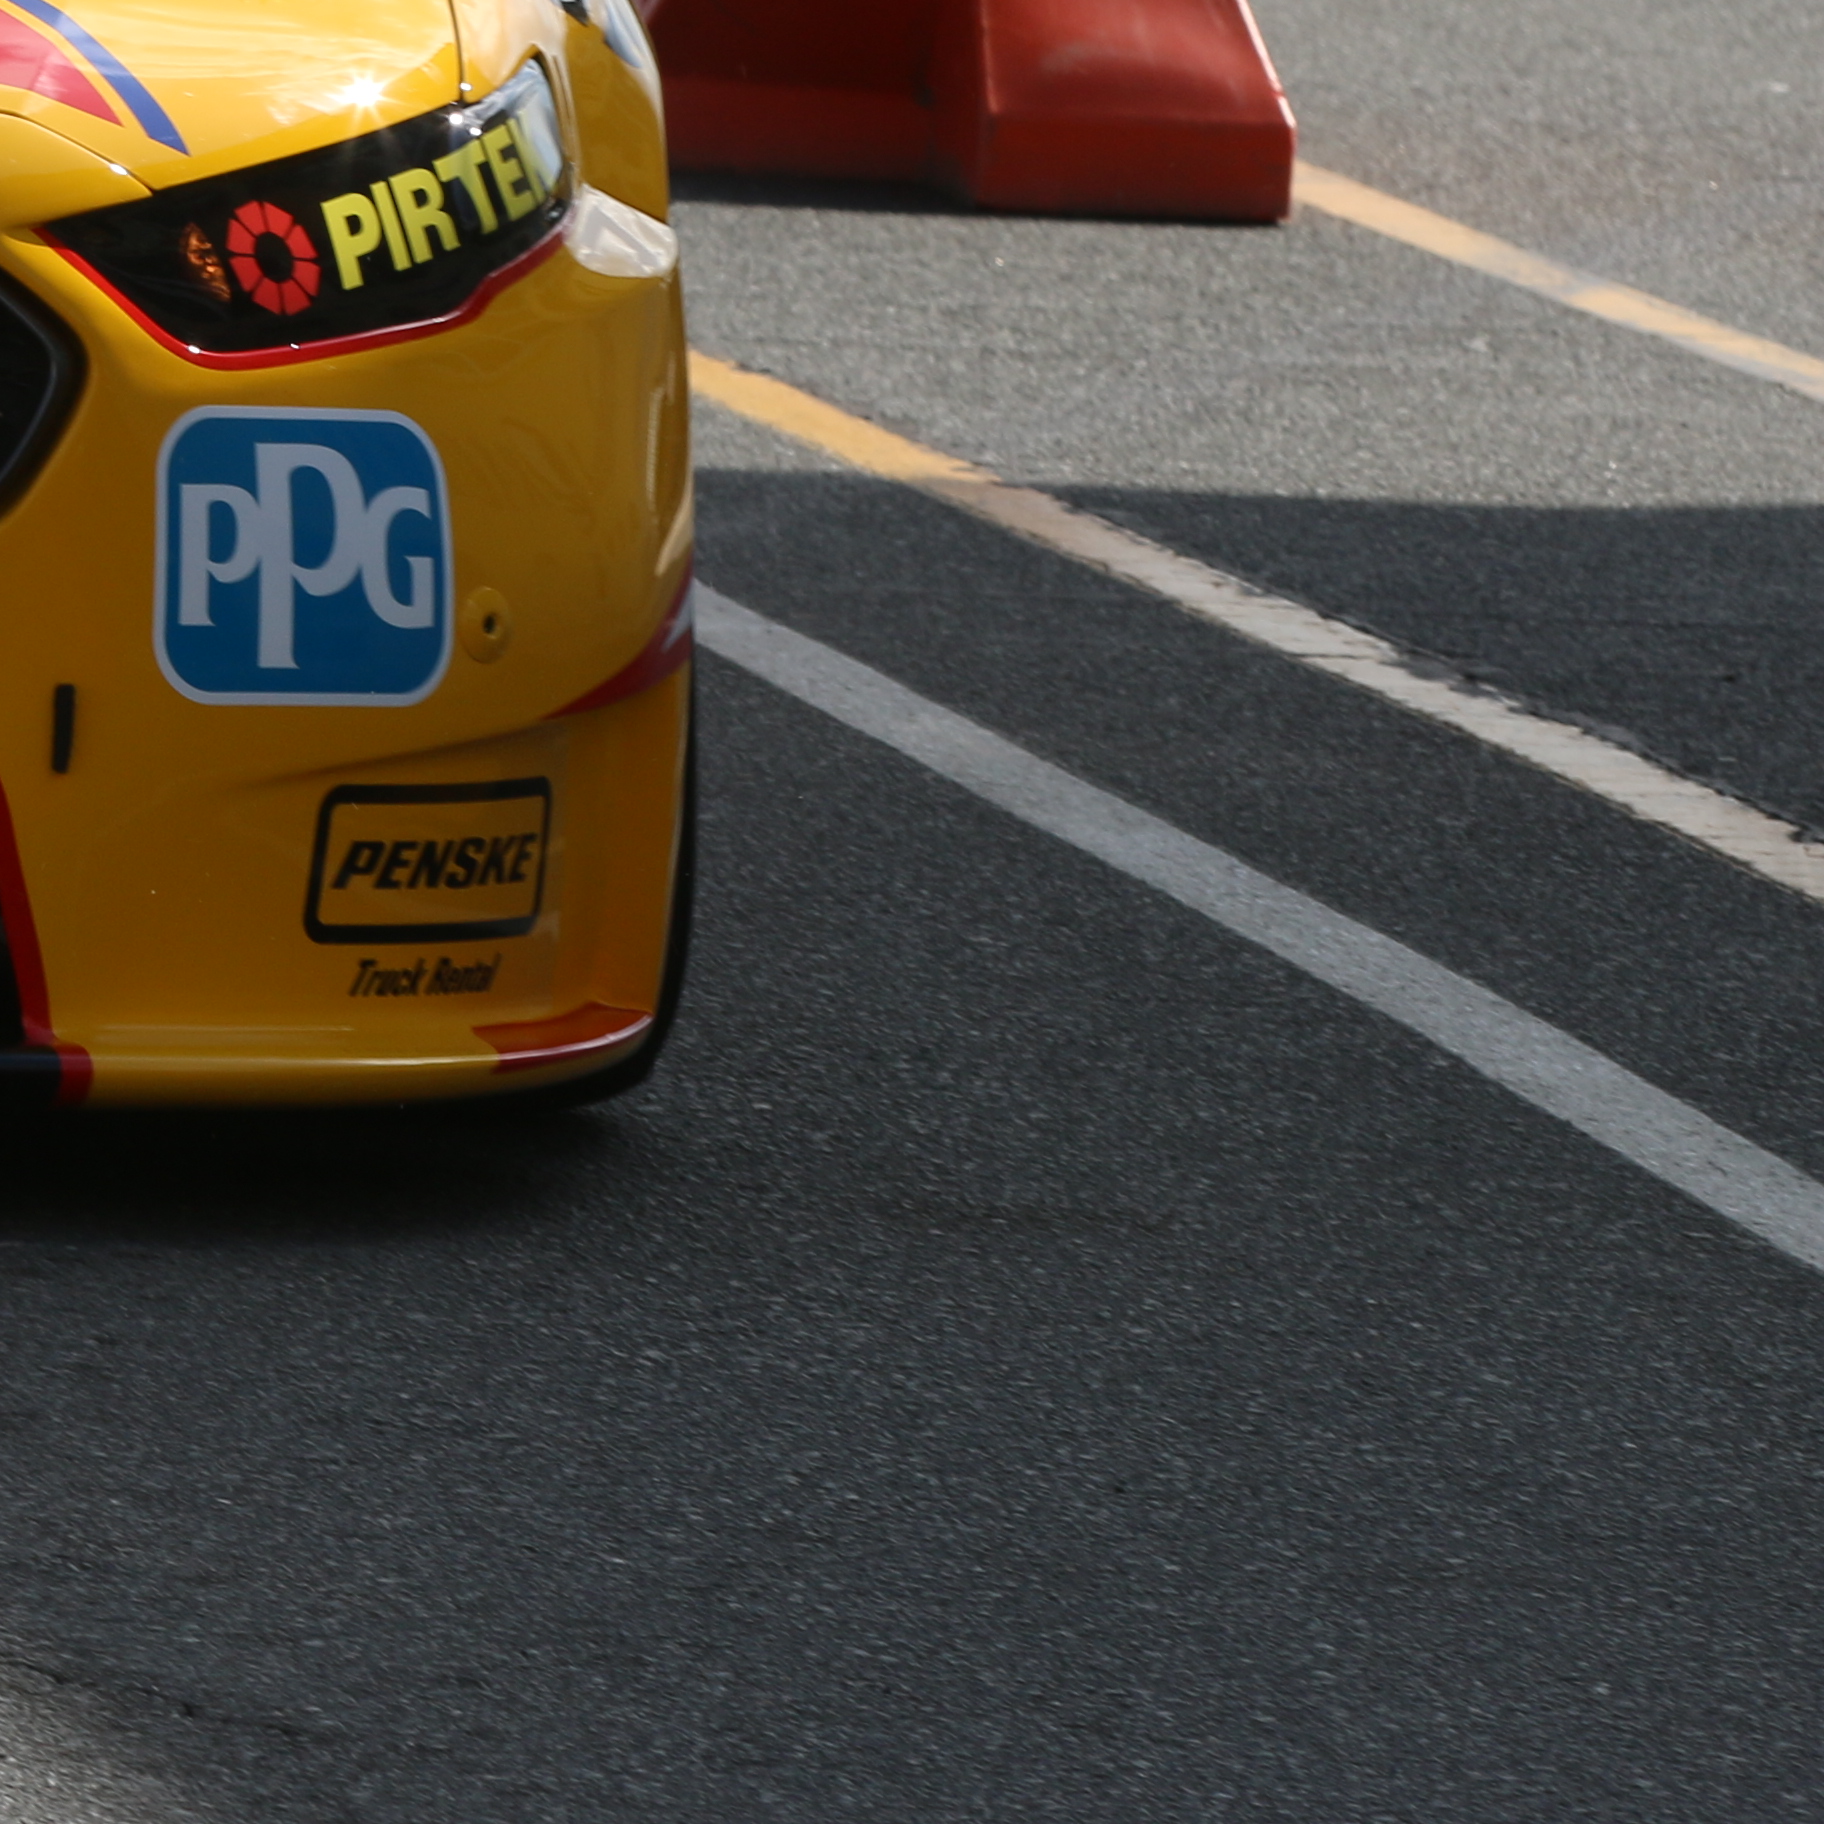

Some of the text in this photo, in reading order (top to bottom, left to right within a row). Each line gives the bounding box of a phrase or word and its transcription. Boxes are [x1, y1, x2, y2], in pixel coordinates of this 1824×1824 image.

[320, 109, 558, 291] PIRTEK
[178, 442, 435, 669] PPG
[331, 832, 538, 890] PENSKE
[348, 952, 502, 997] Truck Rental
